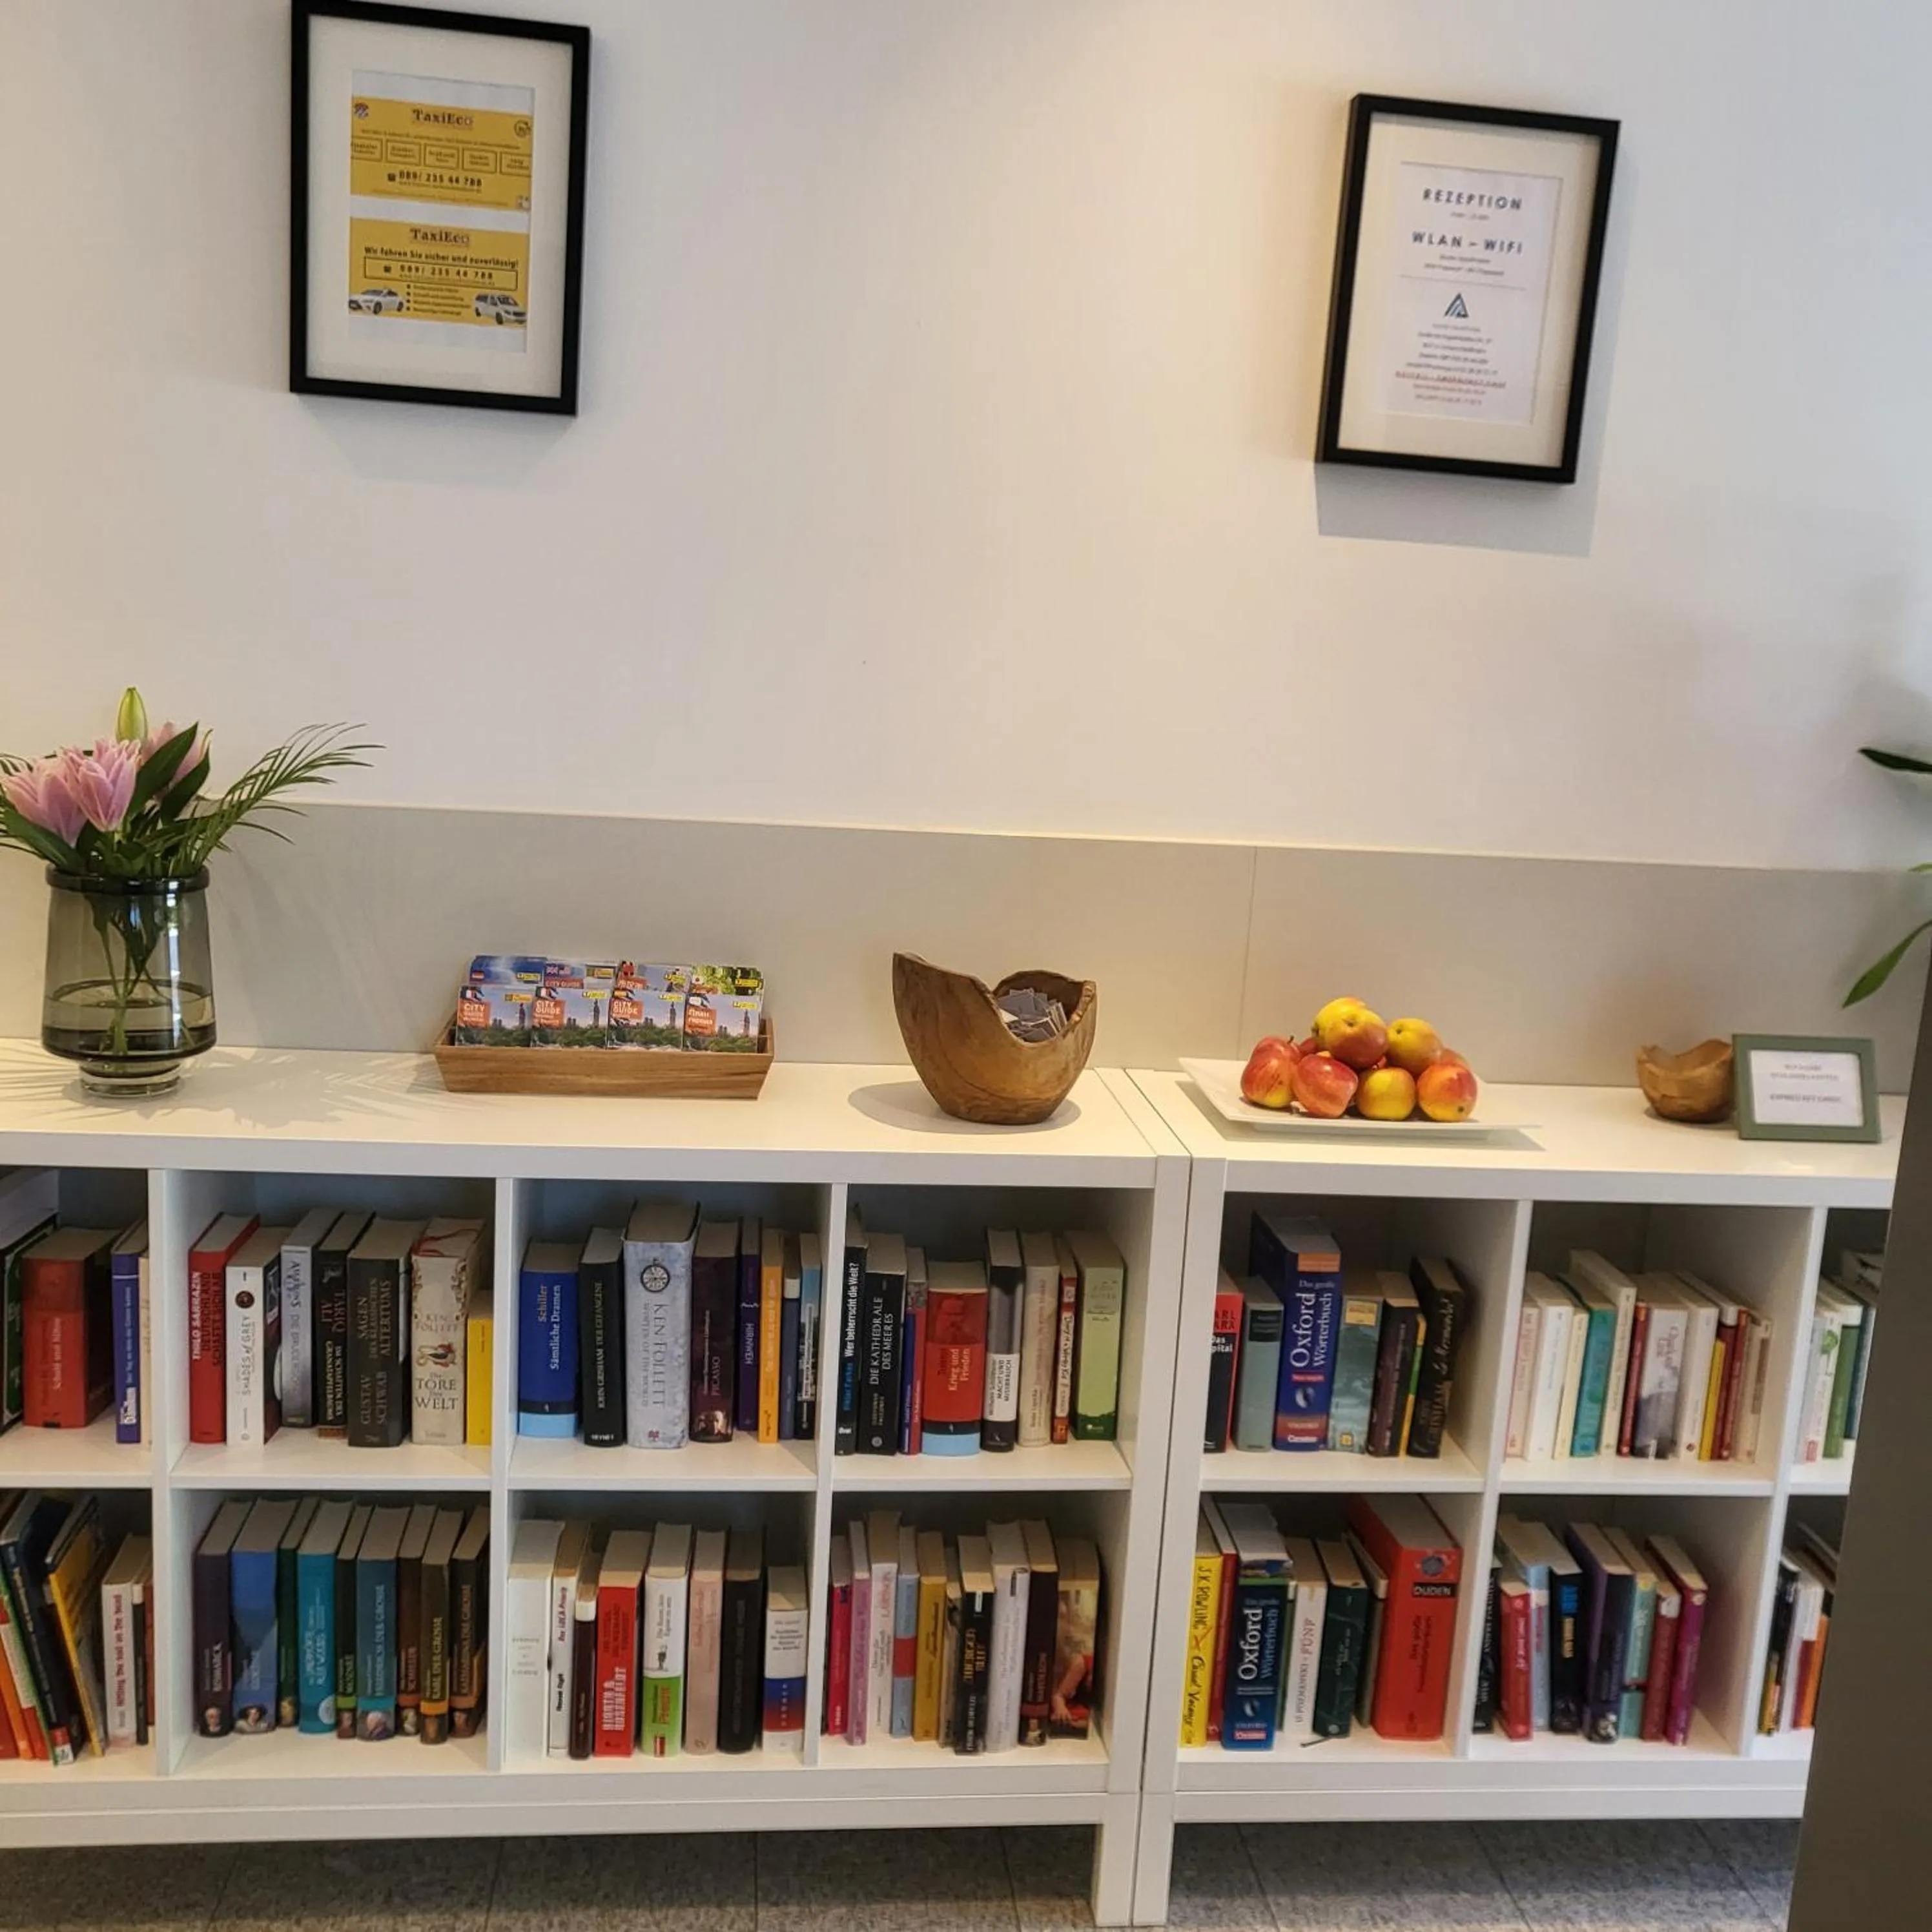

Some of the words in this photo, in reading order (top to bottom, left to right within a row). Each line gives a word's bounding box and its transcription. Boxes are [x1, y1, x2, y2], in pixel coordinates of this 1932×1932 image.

[412, 108, 474, 127] TaxiEco
[1423, 188, 1523, 211] REZEPTION
[409, 228, 469, 244] TaxiEco
[1412, 230, 1463, 248] WLAN
[1484, 238, 1523, 255] WIFI
[380, 247, 408, 258] fahren
[410, 249, 423, 259] Sie
[451, 254, 468, 263] und
[848, 1262, 859, 1285] Welt?
[537, 1284, 548, 1322] Schiller
[551, 1284, 561, 1322] Dramen
[847, 1285, 858, 1298] die
[320, 1300, 332, 1322] ALI
[331, 1289, 345, 1333] TARIQ
[356, 1296, 369, 1339] SAGEN
[380, 1279, 391, 1357] ALTERTUMS
[653, 1303, 669, 1335] KEN
[845, 1299, 858, 1341] beherrscht
[1214, 1310, 1237, 1320] ARL
[241, 1315, 251, 1343] GREY
[745, 1322, 755, 1365] HIRNWEH
[870, 1297, 883, 1366] KATHEDRALE
[883, 1313, 894, 1351] MEERES
[1290, 1291, 1316, 1368] Oxford
[1313, 1292, 1333, 1367] Wörterbuch
[550, 1324, 560, 1370] Sämtliche
[845, 1341, 854, 1357] Wer
[882, 1352, 891, 1370] DES
[949, 1348, 960, 1365] und
[652, 1341, 668, 1410] FOLLETT
[711, 1356, 721, 1397] PICASSO
[869, 1368, 879, 1385] DIE
[947, 1367, 960, 1391] Krieg
[959, 1348, 971, 1382] Frieden
[360, 1374, 372, 1425] GUSTAV
[375, 1371, 389, 1425] SCHWAB
[416, 1378, 457, 1391] TORE
[415, 1397, 458, 1410] WELT
[1192, 1586, 1211, 1630] ROWLING
[1413, 1584, 1452, 1597] DUDEN
[1237, 1608, 1262, 1680] Oxford
[1260, 1608, 1280, 1679] Wörterbuch
[1299, 1618, 1316, 1655] FÜNF
